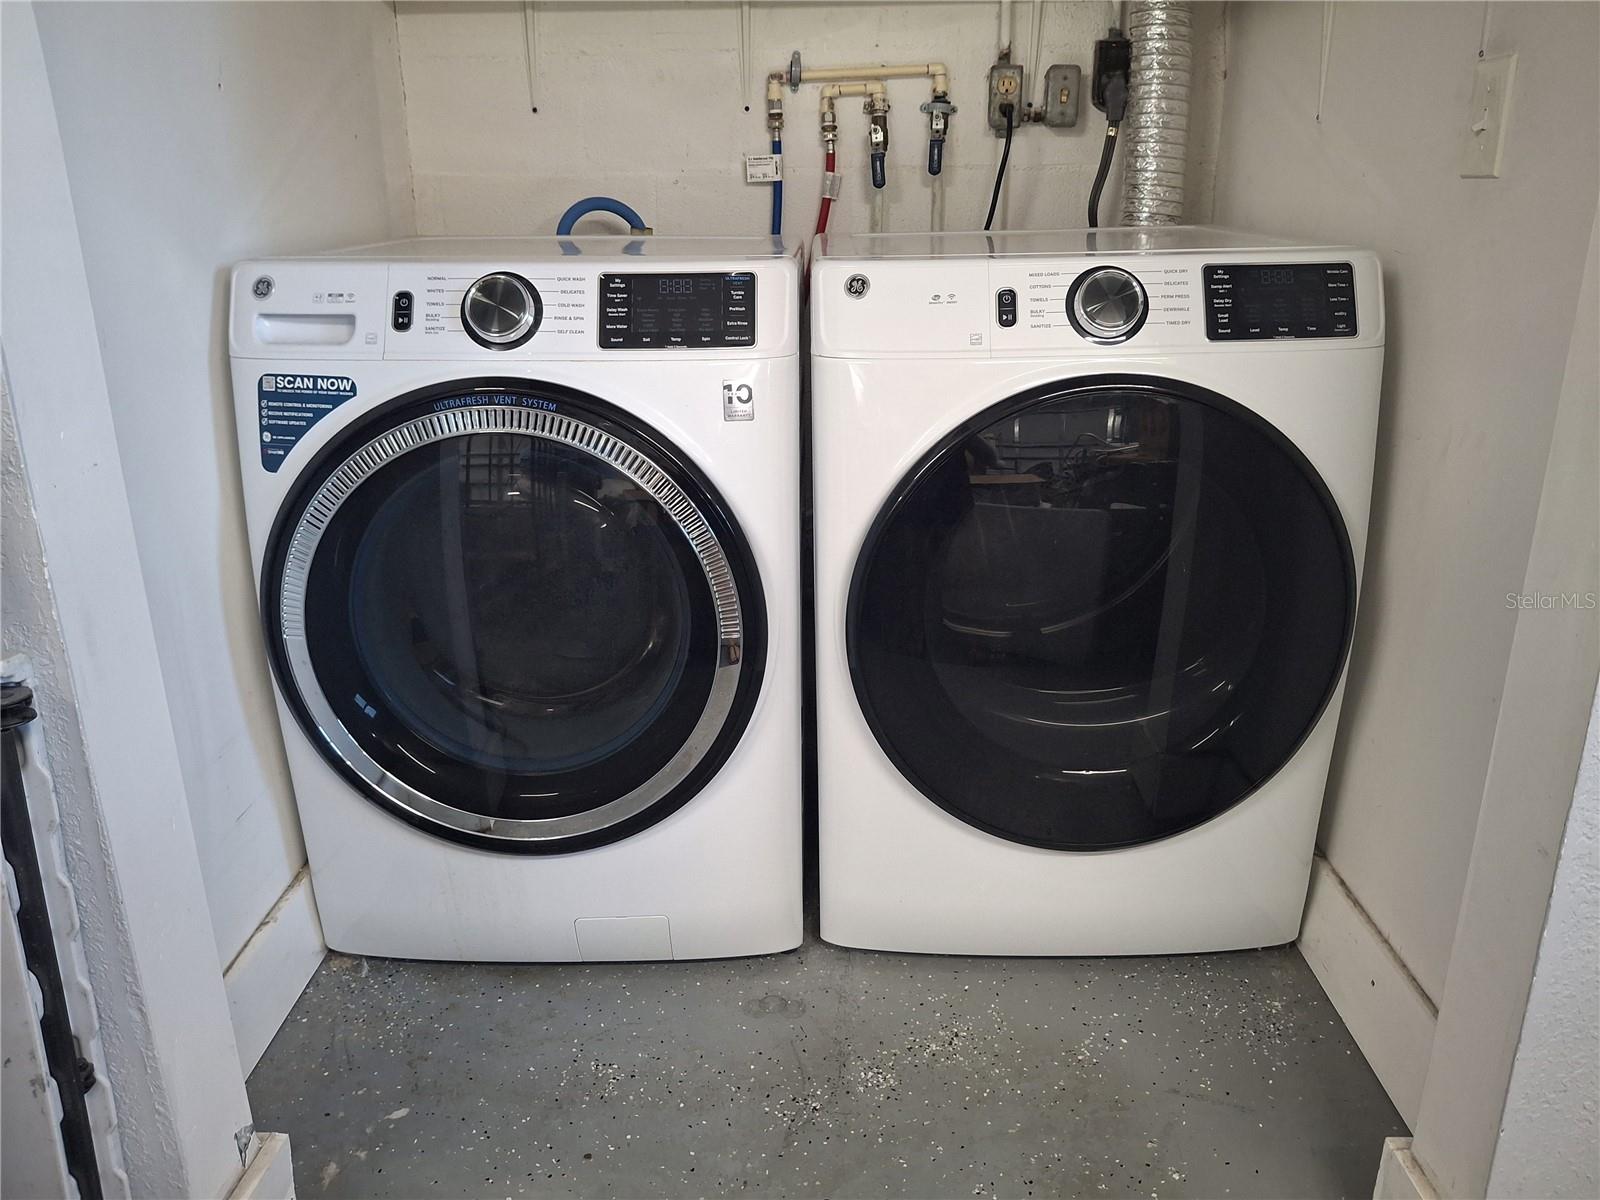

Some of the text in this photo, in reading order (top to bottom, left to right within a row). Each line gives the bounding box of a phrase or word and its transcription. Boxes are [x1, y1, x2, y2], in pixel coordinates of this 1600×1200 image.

[276, 376, 353, 391] SCAN NOW
[433, 395, 557, 411] ULTRAFRESH VENT SYSTEM
